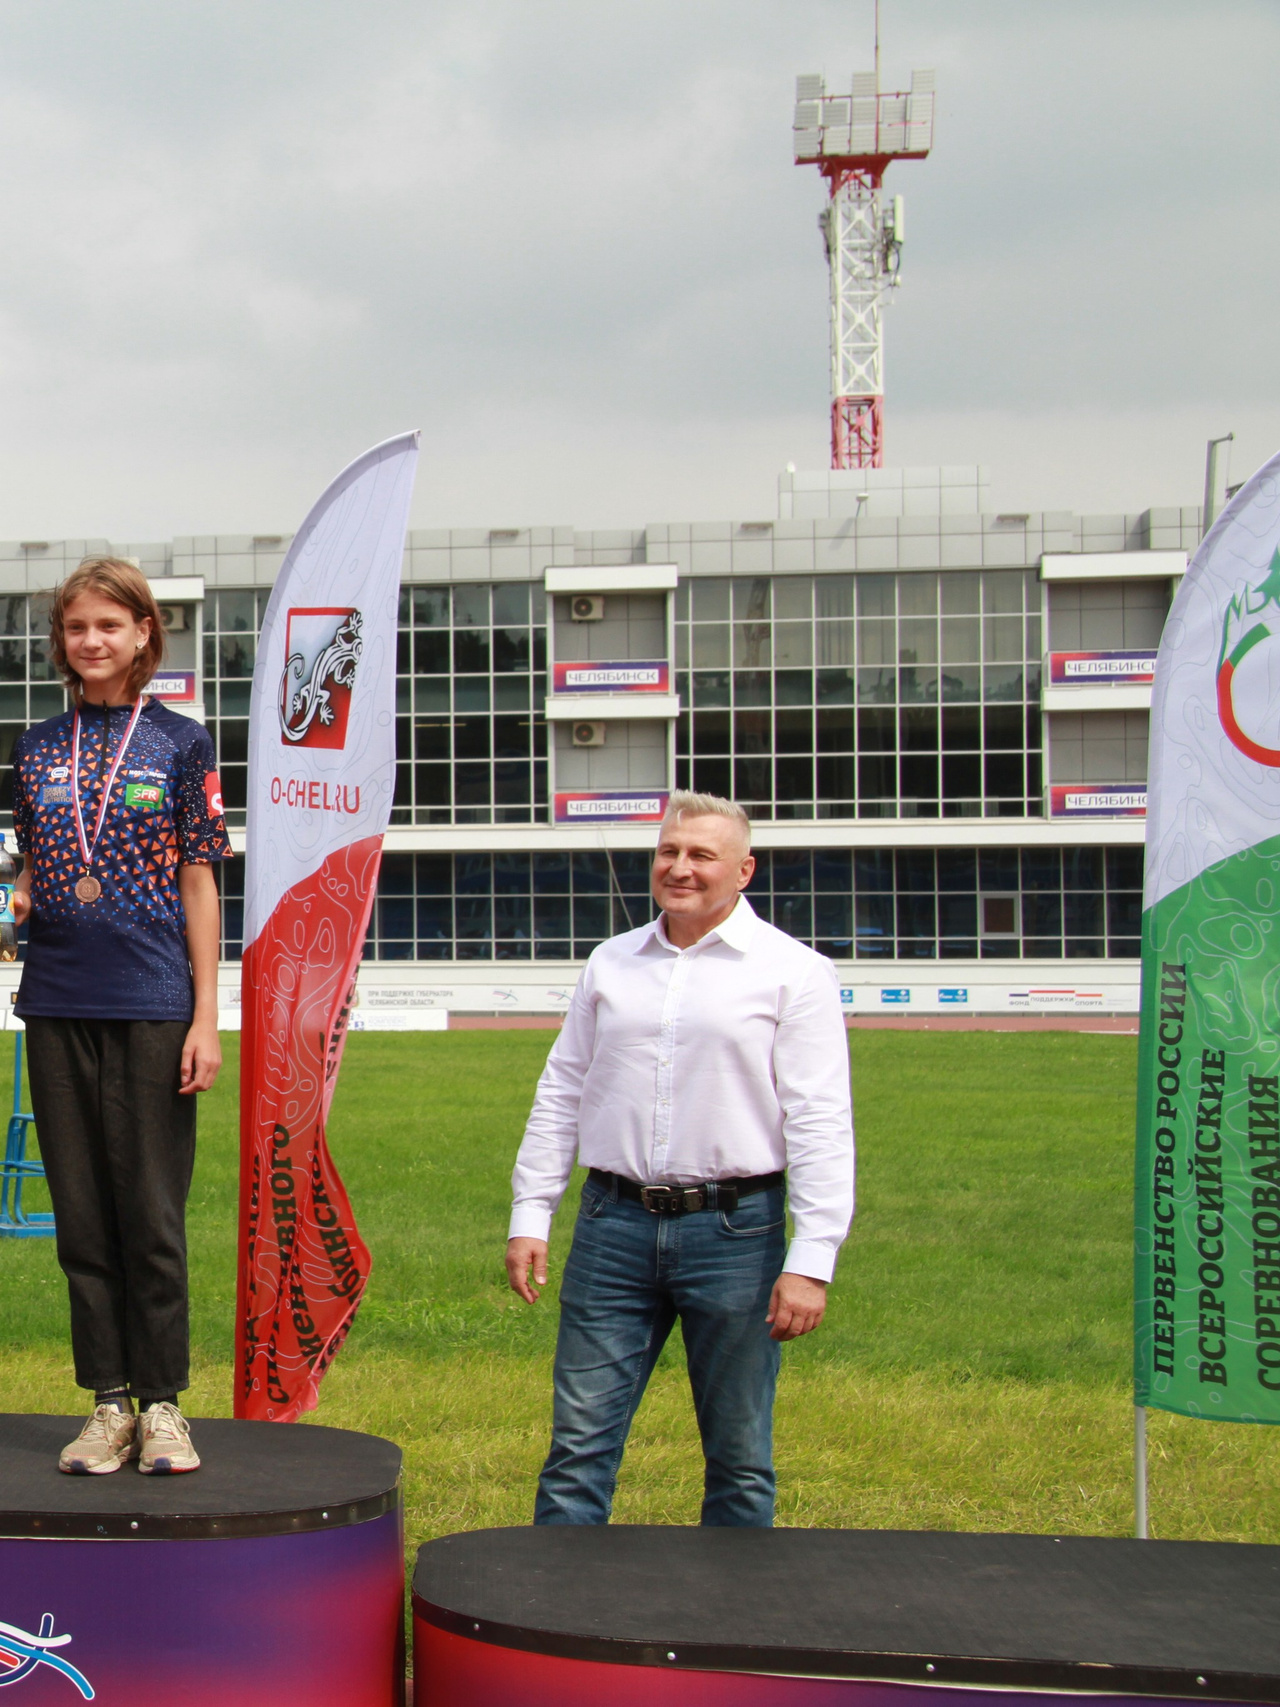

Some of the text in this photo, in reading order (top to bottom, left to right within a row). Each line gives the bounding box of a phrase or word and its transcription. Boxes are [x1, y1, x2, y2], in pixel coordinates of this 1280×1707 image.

[568, 671, 657, 683] ЧЕЛЯБИНСК
[133, 788, 157, 801] SFR
[270, 775, 361, 815] O-CHEL.RU
[569, 799, 658, 813] ЧЕЛЯБИНСК
[1068, 795, 1147, 806] ЧЕЛЯБИНС
[1153, 961, 1188, 1378] ПЕРВЕНСТВО РОССИИ
[1187, 1048, 1228, 1388] ВСЕРОССИЙСКИЕ
[1248, 1073, 1280, 1391] СОРЕВНОВАНИЯ
